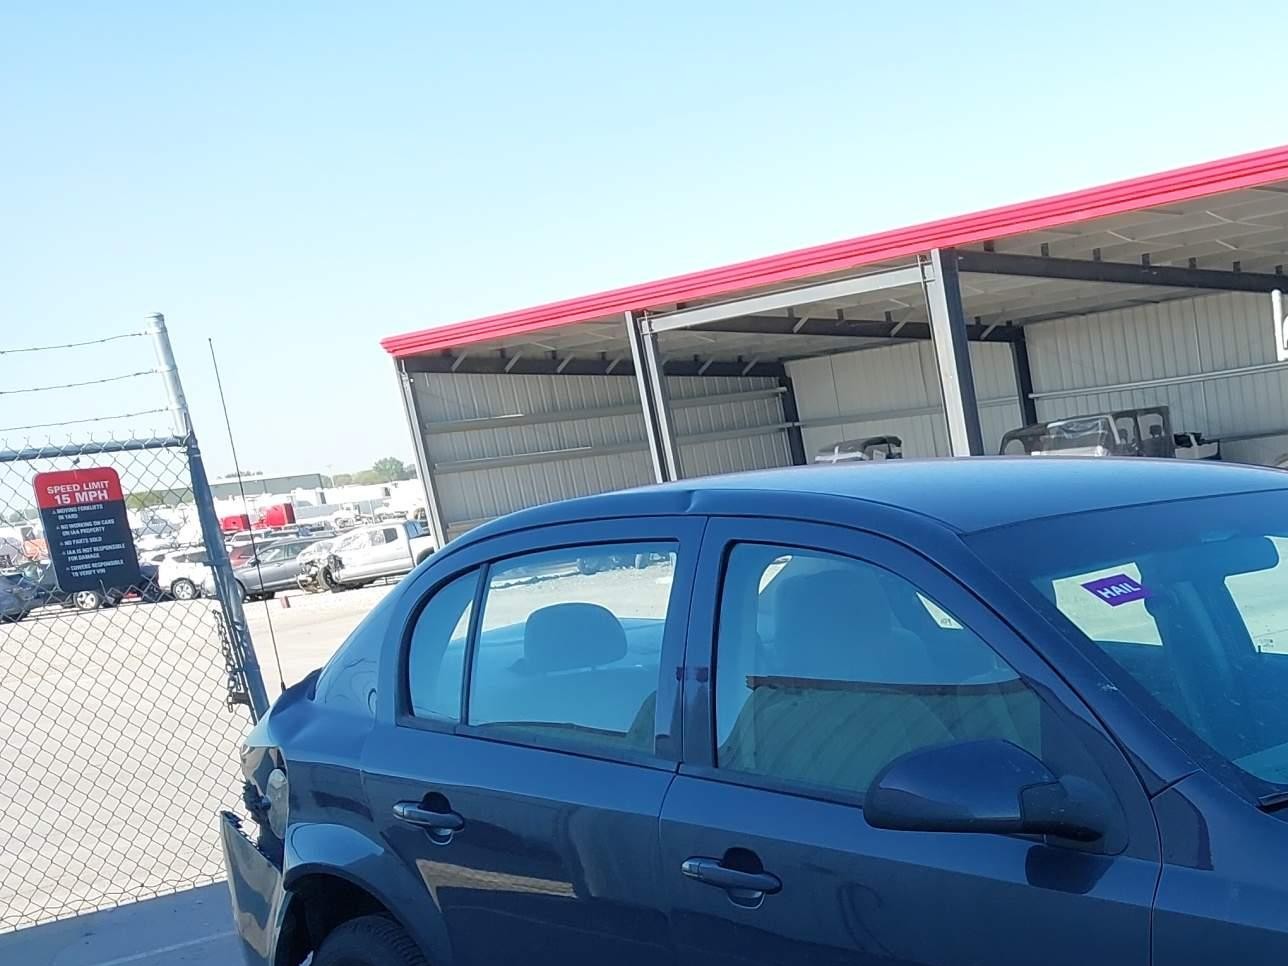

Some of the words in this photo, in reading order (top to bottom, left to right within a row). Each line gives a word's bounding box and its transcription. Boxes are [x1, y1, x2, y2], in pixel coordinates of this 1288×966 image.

[47, 484, 80, 495] SPEED
[82, 480, 110, 491] LIMIT
[54, 494, 71, 505] 15
[75, 490, 109, 503] MPH
[80, 526, 105, 534] PROPERTY
[72, 537, 89, 545] PARTS
[93, 543, 125, 552] RESPONSIBLE
[78, 553, 100, 561] DAMAGE
[91, 559, 124, 568] RESPONSIBLE
[1097, 583, 1141, 598] HAIL
